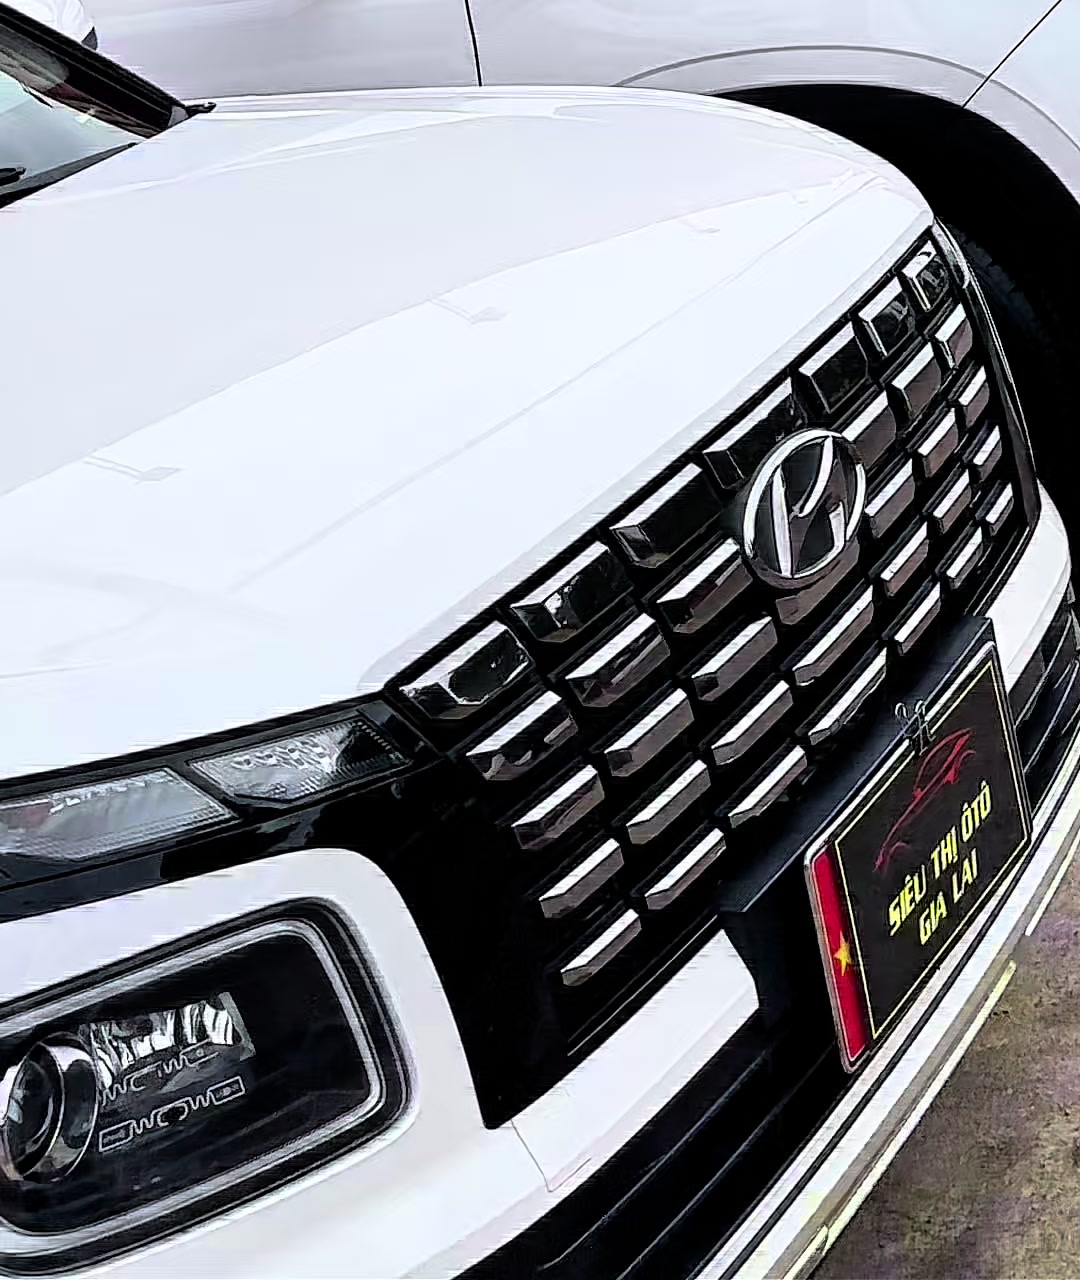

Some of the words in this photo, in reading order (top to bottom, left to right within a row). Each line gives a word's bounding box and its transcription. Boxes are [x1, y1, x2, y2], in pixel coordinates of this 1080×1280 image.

[931, 825, 958, 880] THỊ
[918, 891, 948, 946] GIA
[952, 847, 979, 904] LAI
